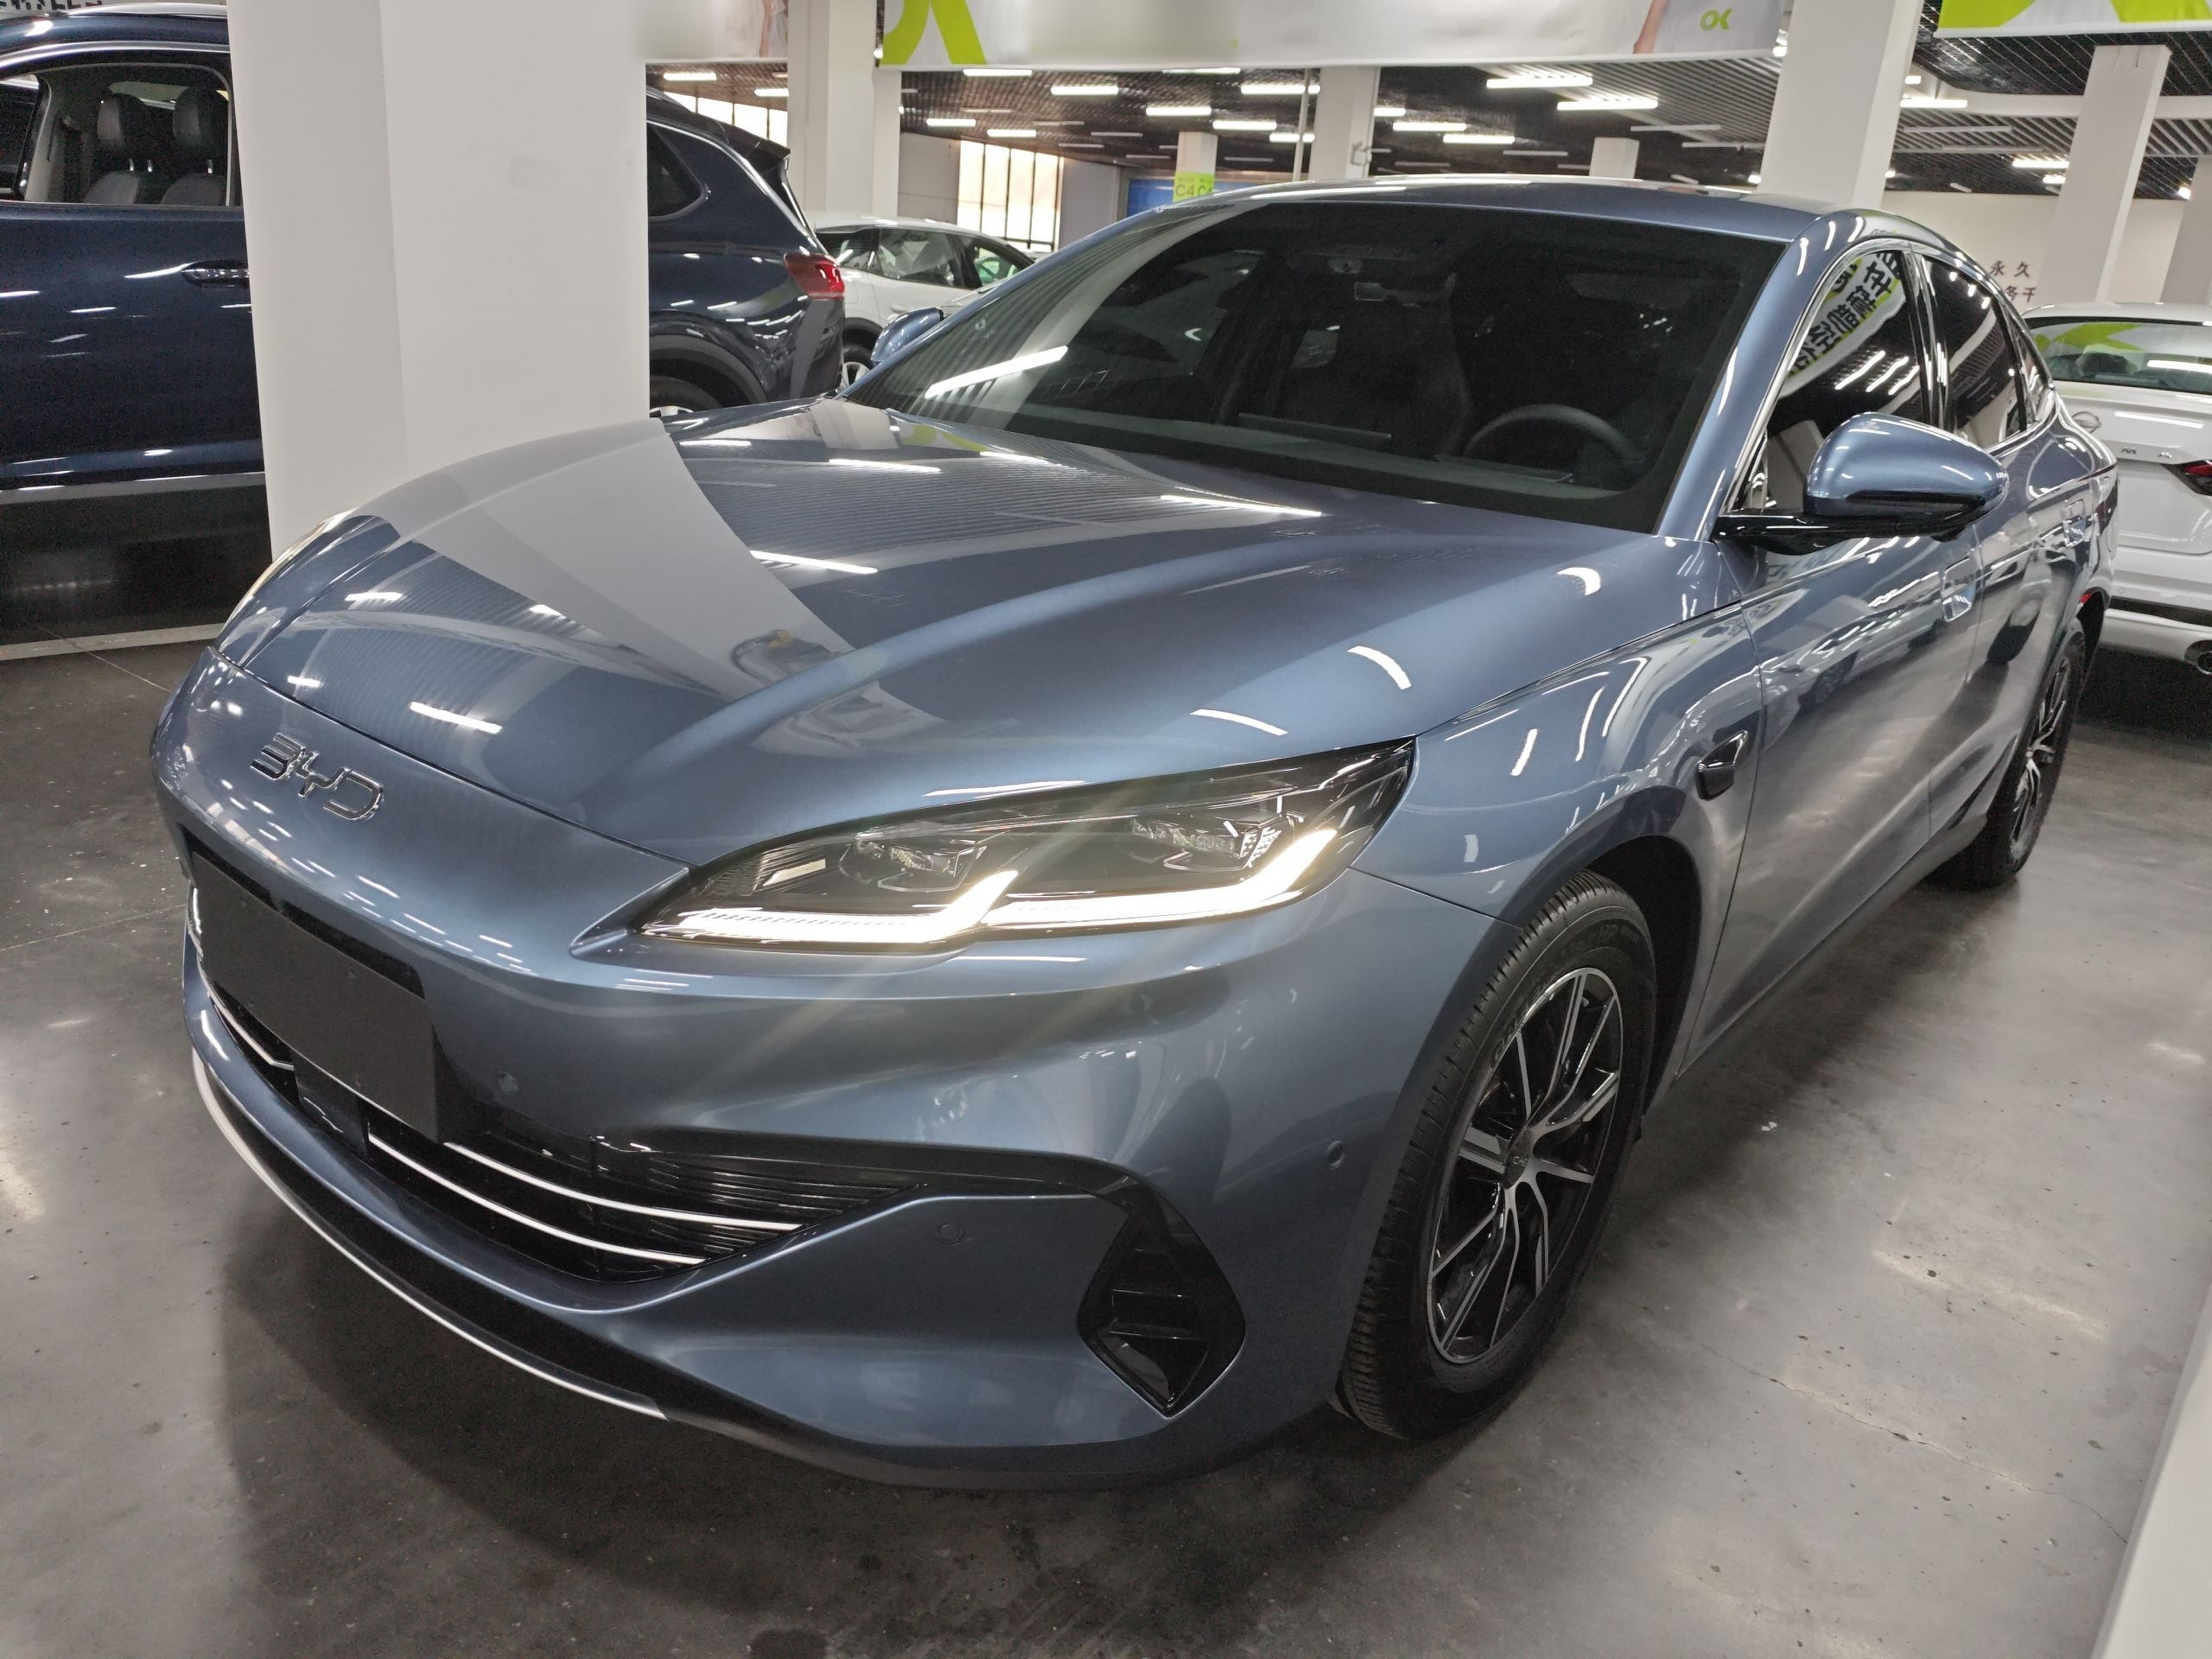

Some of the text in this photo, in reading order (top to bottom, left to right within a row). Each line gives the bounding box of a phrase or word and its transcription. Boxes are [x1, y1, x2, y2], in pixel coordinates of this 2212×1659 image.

[1176, 184, 1194, 197] C4
[1989, 260, 2030, 277] 永久
[249, 732, 385, 823] BYD
